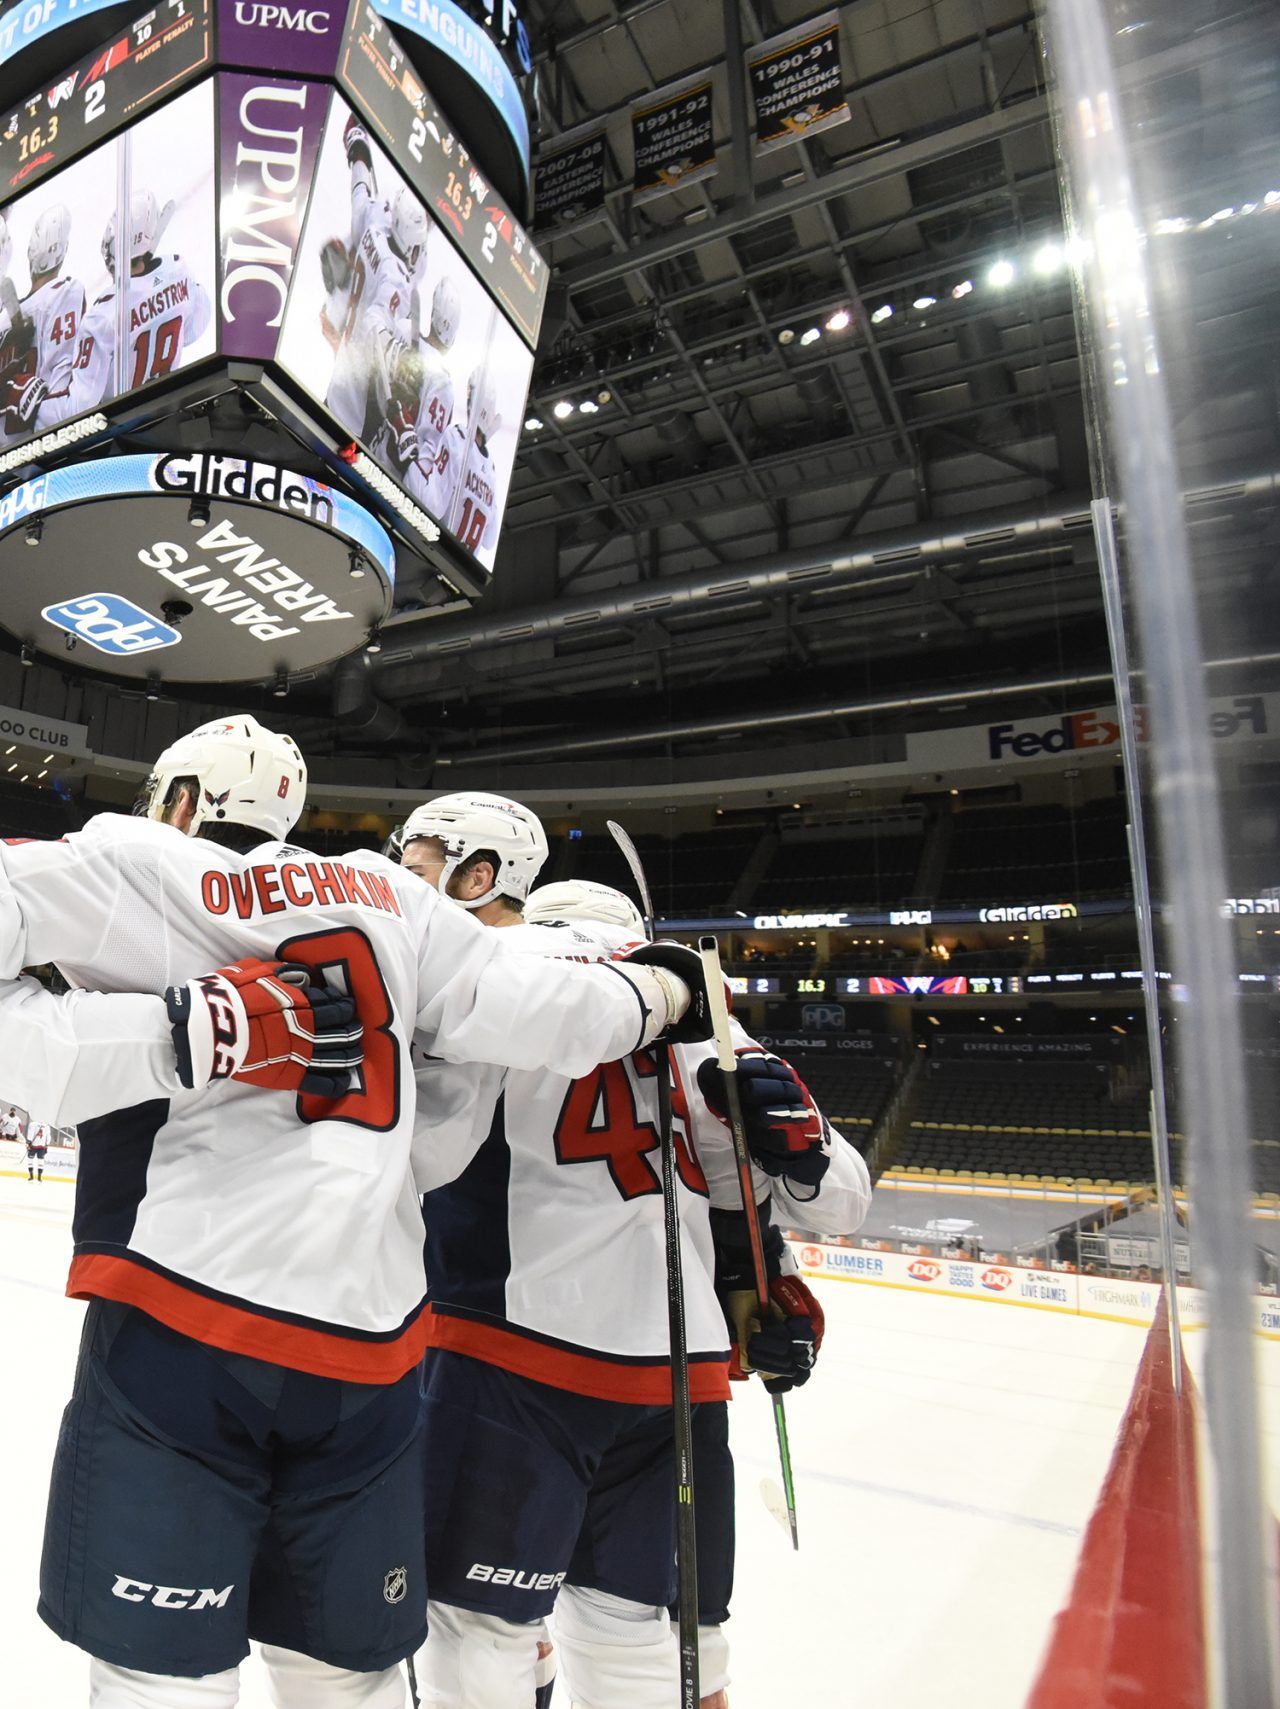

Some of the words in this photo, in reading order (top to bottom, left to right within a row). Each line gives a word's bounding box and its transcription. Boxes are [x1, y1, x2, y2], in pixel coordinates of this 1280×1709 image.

[233, 2, 330, 34] UPMC
[135, 41, 161, 64] PLAYER
[163, 18, 194, 45] PENALTY
[754, 38, 835, 83] 1990-91
[755, 64, 841, 107] CONFERENCE
[772, 63, 821, 90] WALES
[84, 79, 106, 125] 2
[636, 95, 709, 134] 1991-92
[759, 77, 841, 118] CHAMPIONS
[19, 116, 59, 161] 16.3
[407, 117, 427, 163] 2
[635, 119, 711, 158] CONFERENCE
[650, 118, 694, 142] WALES
[637, 132, 711, 168] CHAMPIONS
[221, 85, 308, 328] UPMC
[444, 172, 473, 220] 16.3
[481, 221, 497, 265] 2
[50, 310, 76, 346] 43
[41, 413, 108, 454] ELECTRIC
[428, 396, 446, 433] 43
[153, 453, 335, 527] Glidden
[195, 518, 355, 624] ARENA
[137, 541, 301, 643] PAINTS
[58, 598, 165, 652] PPG
[28, 727, 70, 748] CLUB
[277, 774, 290, 800] 8
[201, 862, 402, 920] OVECHKIN
[753, 912, 850, 930] OLYMPIC
[757, 979, 769, 993] 2
[797, 979, 826, 993] 16.3
[847, 979, 860, 993] 2
[192, 973, 238, 1082] CCM
[275, 925, 401, 1134] 8
[804, 1006, 844, 1029] PPG
[774, 1038, 827, 1048] LEXUS
[837, 1039, 874, 1050] LOGES
[826, 1252, 884, 1272] LUMBER
[910, 1263, 940, 1280] DQ
[984, 1273, 1012, 1287] DQ
[949, 1277, 975, 1288] GOOD
[1021, 1283, 1039, 1299] LIVE
[1040, 1286, 1068, 1303] GAMES
[1093, 1288, 1140, 1308] HIGHMARK
[111, 1573, 235, 1612] CCM
